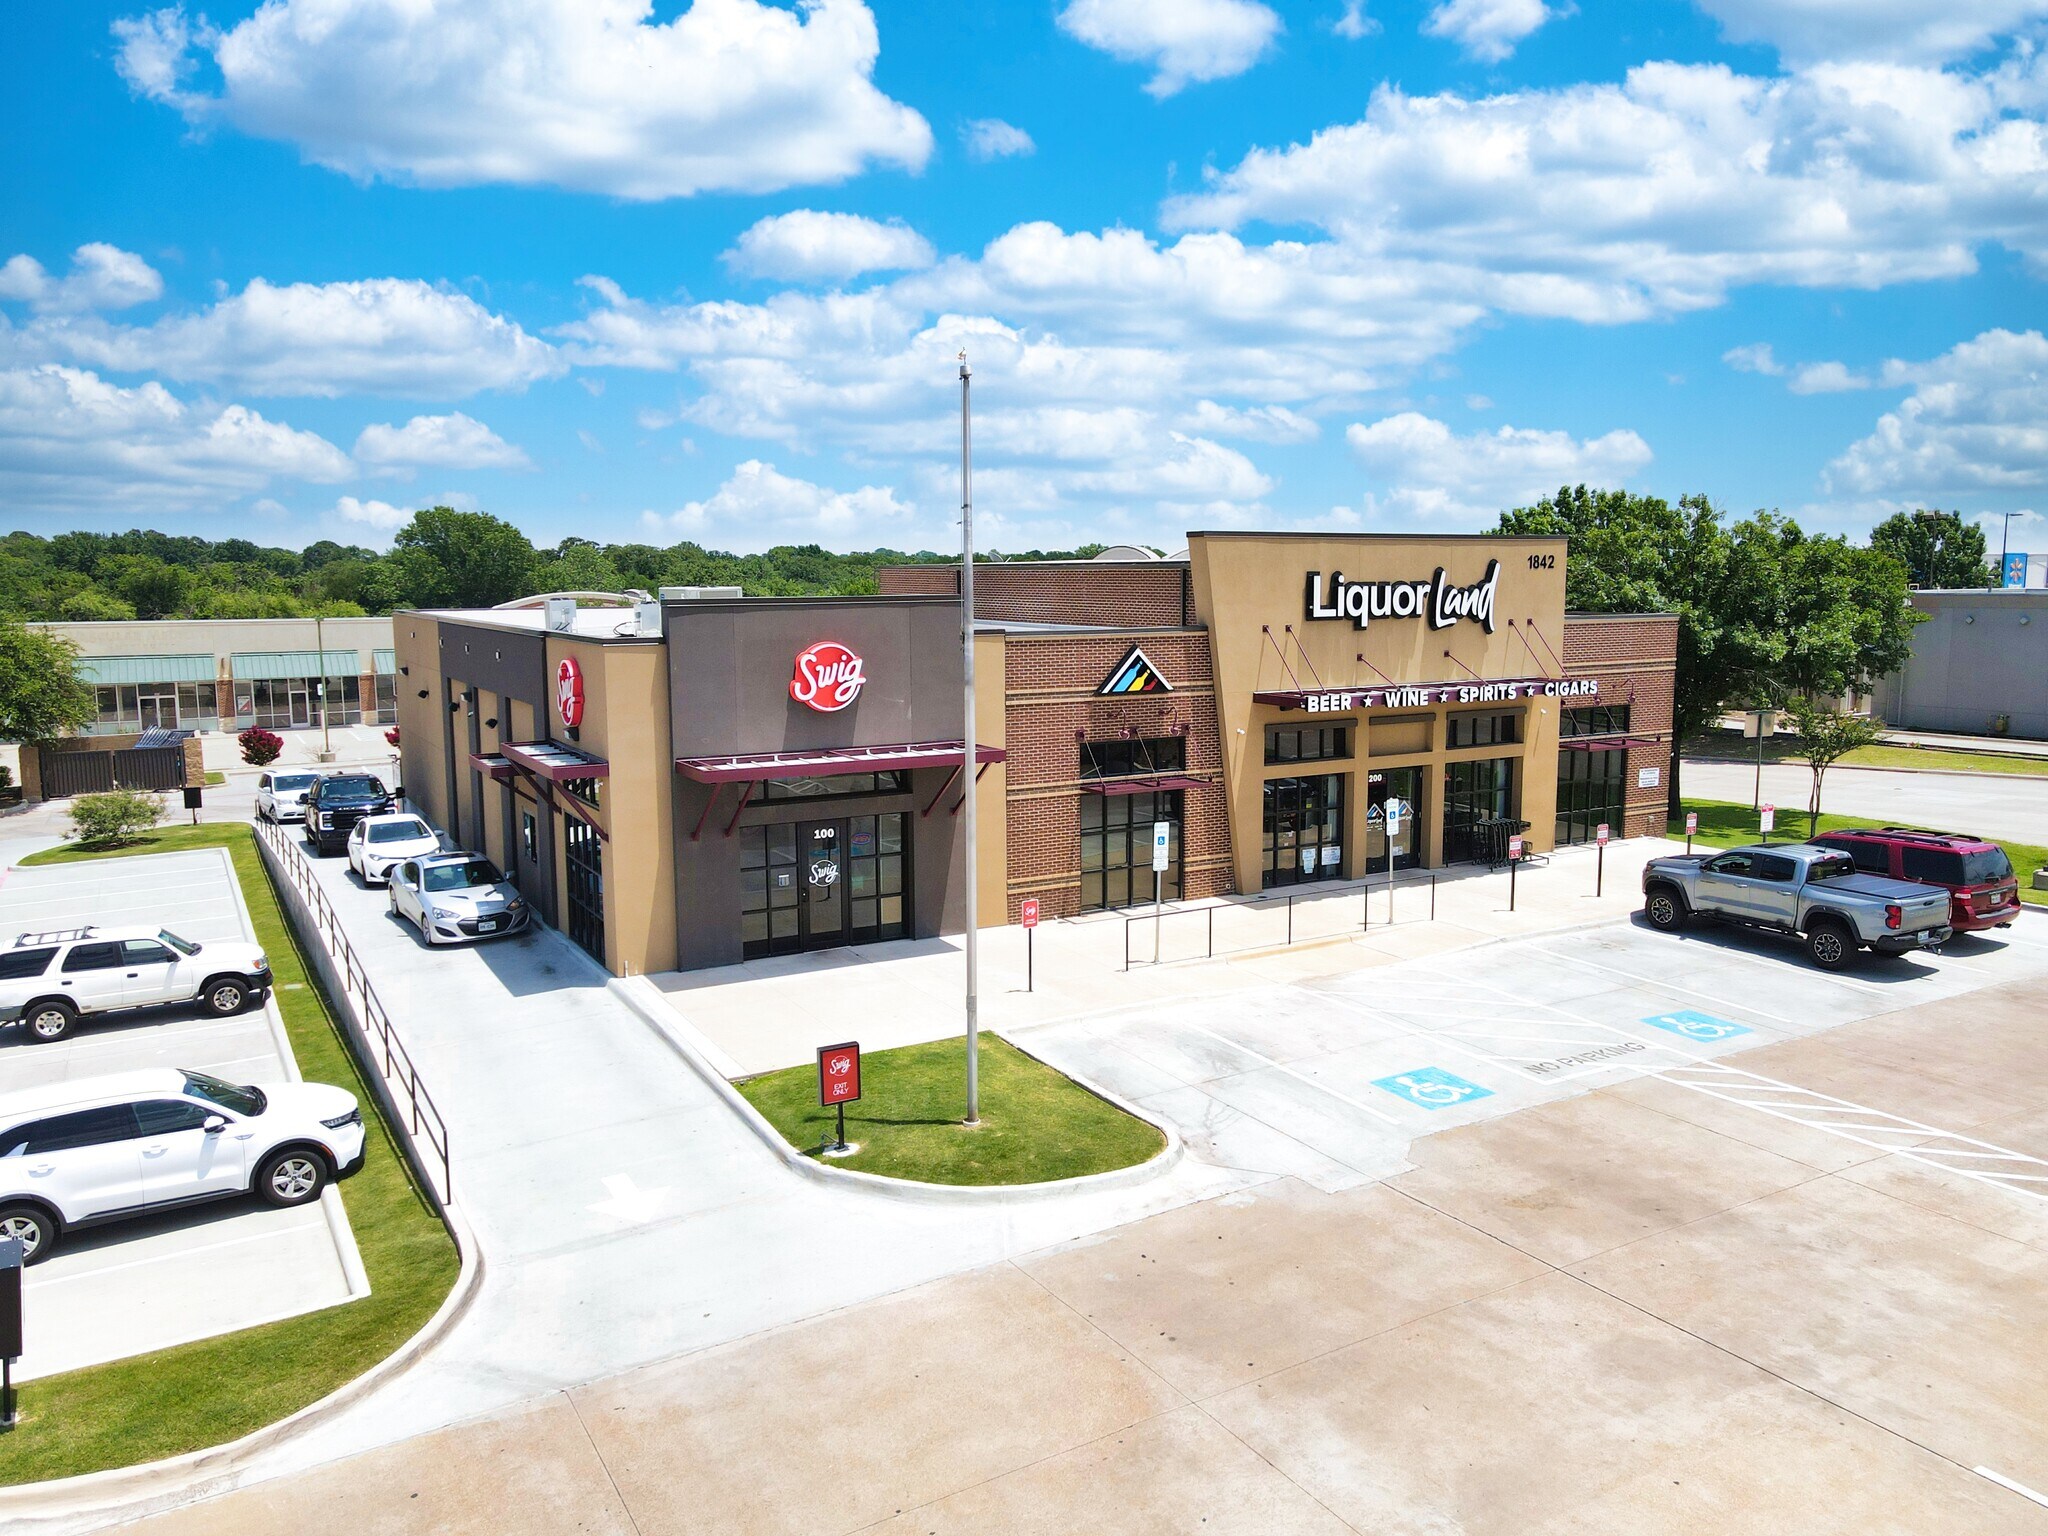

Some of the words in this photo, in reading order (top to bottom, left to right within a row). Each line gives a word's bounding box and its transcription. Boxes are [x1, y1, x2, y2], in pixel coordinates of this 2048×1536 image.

[1527, 555, 1555, 569] 1842
[794, 653, 867, 702] Swig
[1307, 694, 1352, 713] BEER
[1384, 689, 1429, 708] WINE
[1459, 684, 1518, 704] SPIRITS
[1544, 680, 1599, 697] CIGARS
[1368, 773, 1383, 783] 200
[813, 827, 835, 840] 100
[808, 863, 839, 885] Swig
[1523, 1060, 1561, 1075] NO
[1556, 1041, 1647, 1068] PARKING
[829, 1058, 851, 1075] Swig
[832, 1087, 849, 1096] ONLY
[833, 1081, 848, 1090] EXIT
